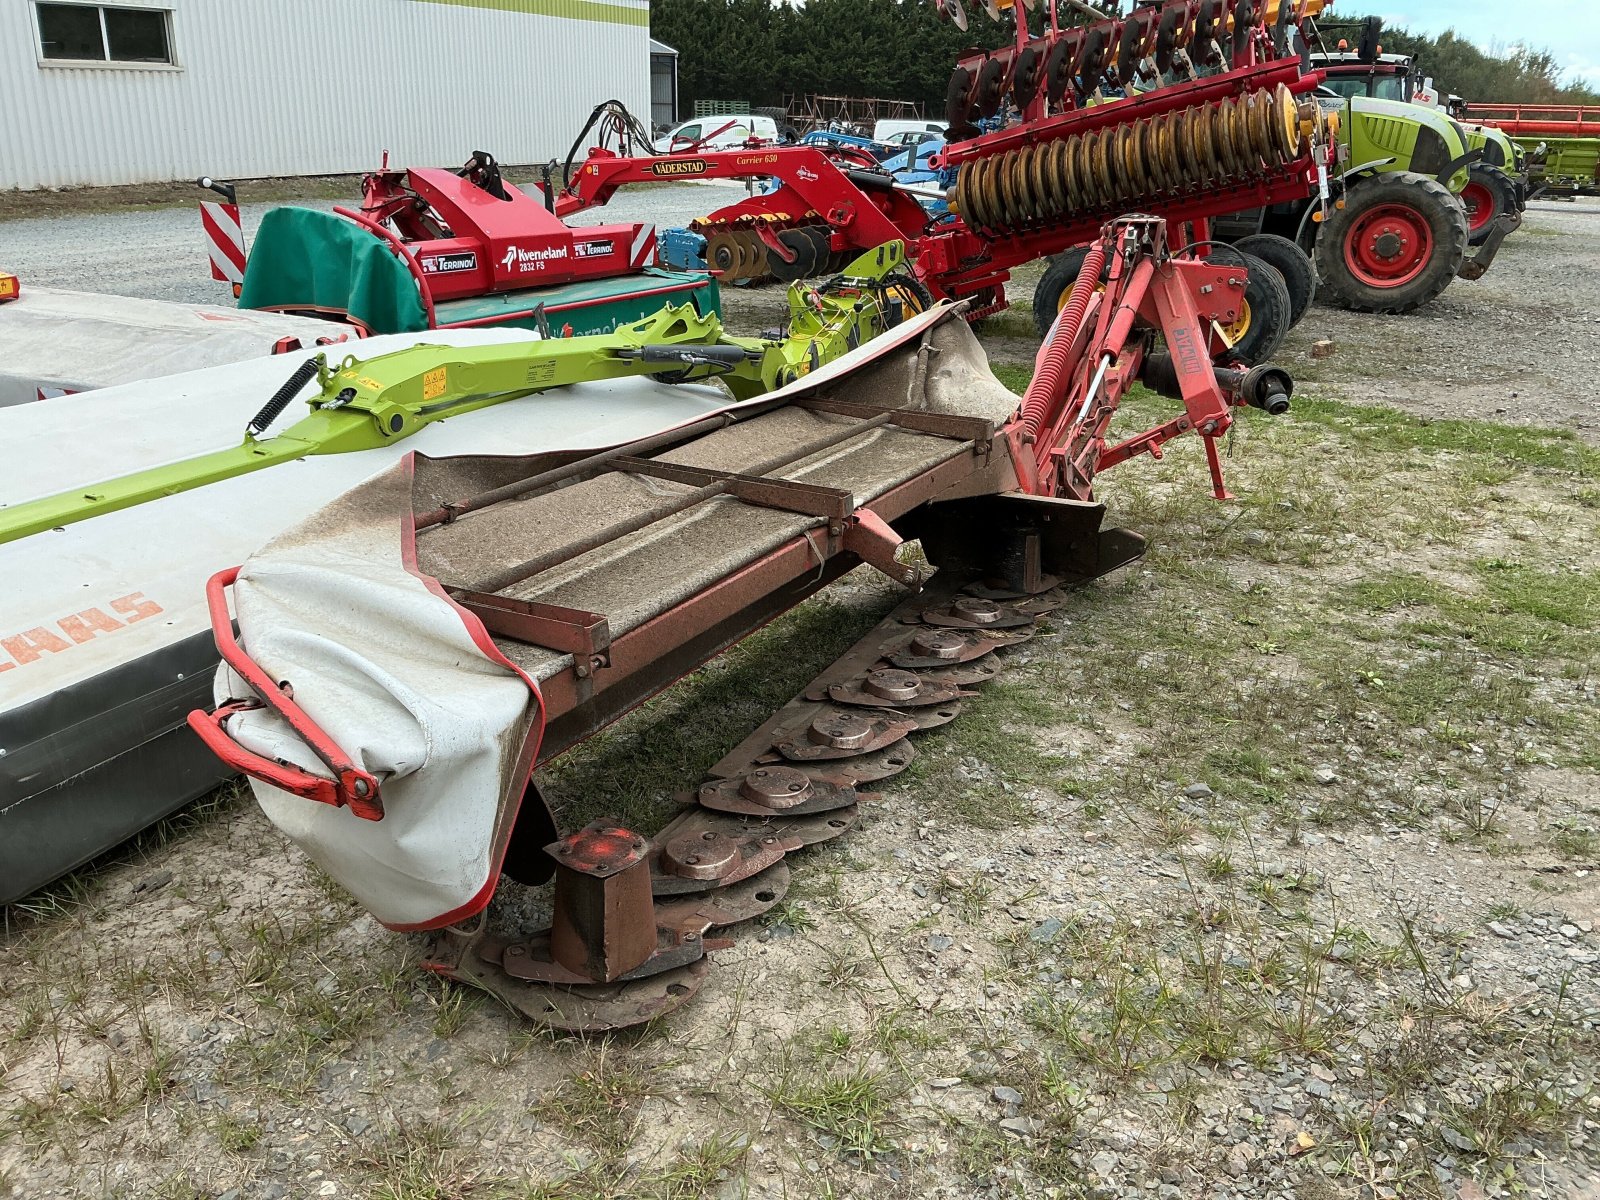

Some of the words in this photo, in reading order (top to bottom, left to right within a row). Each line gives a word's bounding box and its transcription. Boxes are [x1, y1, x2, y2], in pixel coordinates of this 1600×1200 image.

[736, 156, 763, 165] Carrier
[764, 154, 778, 163] 650
[655, 161, 703, 174] VÄDERSTAD
[518, 245, 568, 262] Kverneland
[520, 263, 535, 272] 2832
[536, 261, 545, 270] FS
